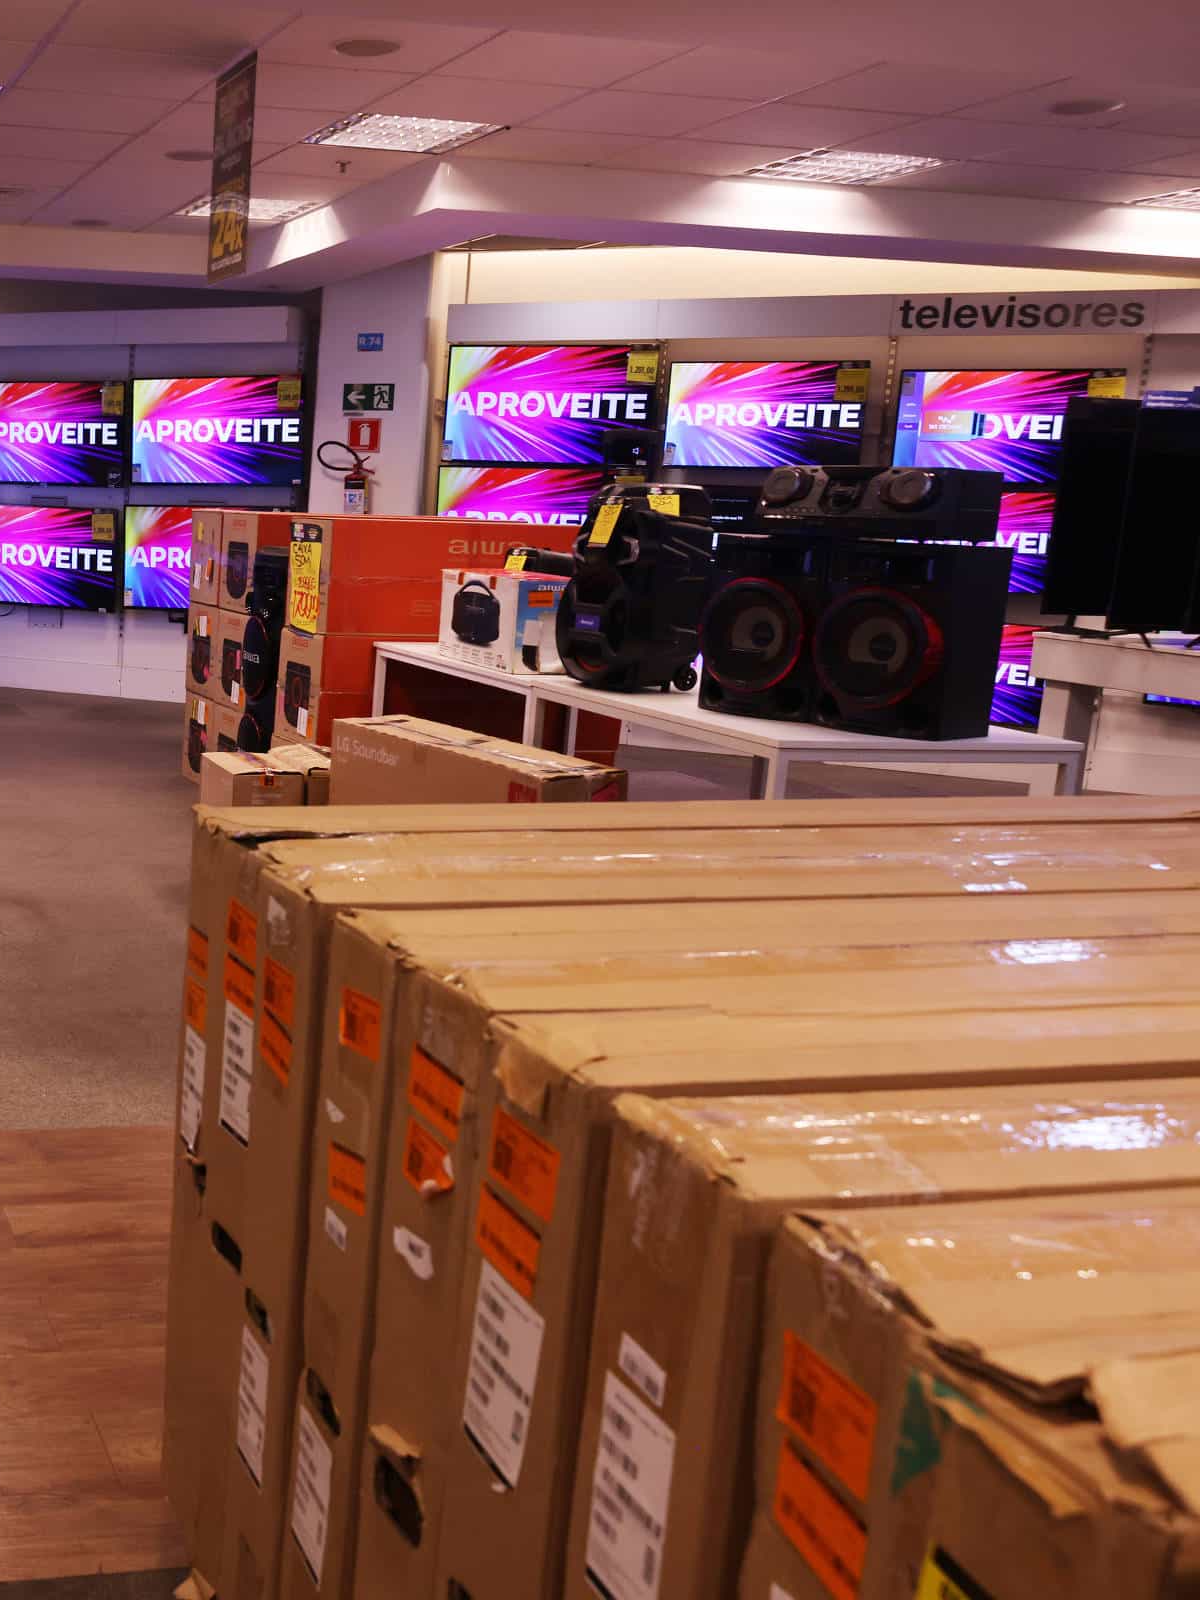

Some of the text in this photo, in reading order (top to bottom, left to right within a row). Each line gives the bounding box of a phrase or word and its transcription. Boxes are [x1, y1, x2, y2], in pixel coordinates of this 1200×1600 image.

[899, 296, 1145, 329] televisores
[451, 391, 648, 420] APROVEITE
[669, 403, 861, 428] APROVEITE
[135, 418, 299, 443] APROVEITE
[336, 736, 399, 767] LG Soundbar
